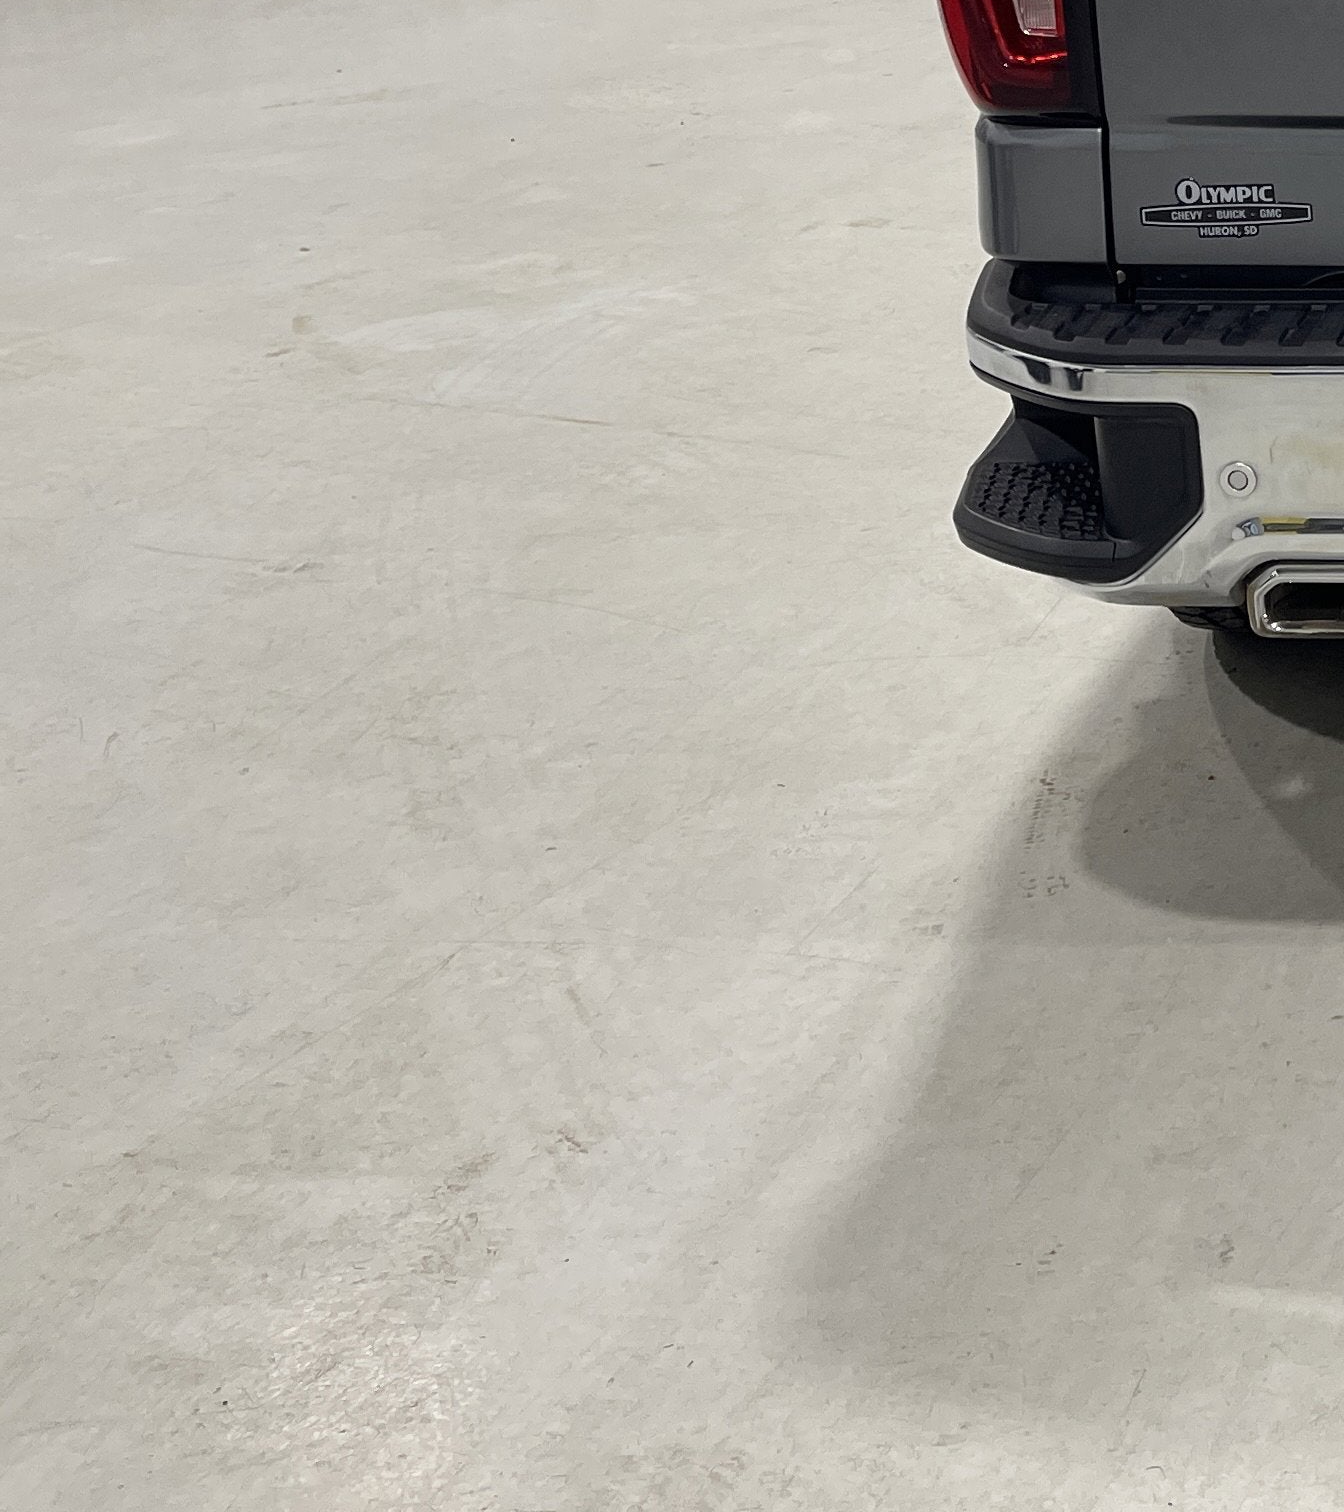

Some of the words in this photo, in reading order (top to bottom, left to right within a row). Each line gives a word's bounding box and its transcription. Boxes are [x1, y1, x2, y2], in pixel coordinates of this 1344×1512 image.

[1176, 179, 1274, 204] OLYMPIC
[1171, 210, 1203, 221] CHEVY
[1216, 209, 1247, 220] BUICK
[1259, 208, 1282, 219] GMC
[1200, 226, 1241, 237] HURON,
[1244, 225, 1258, 236] SD
